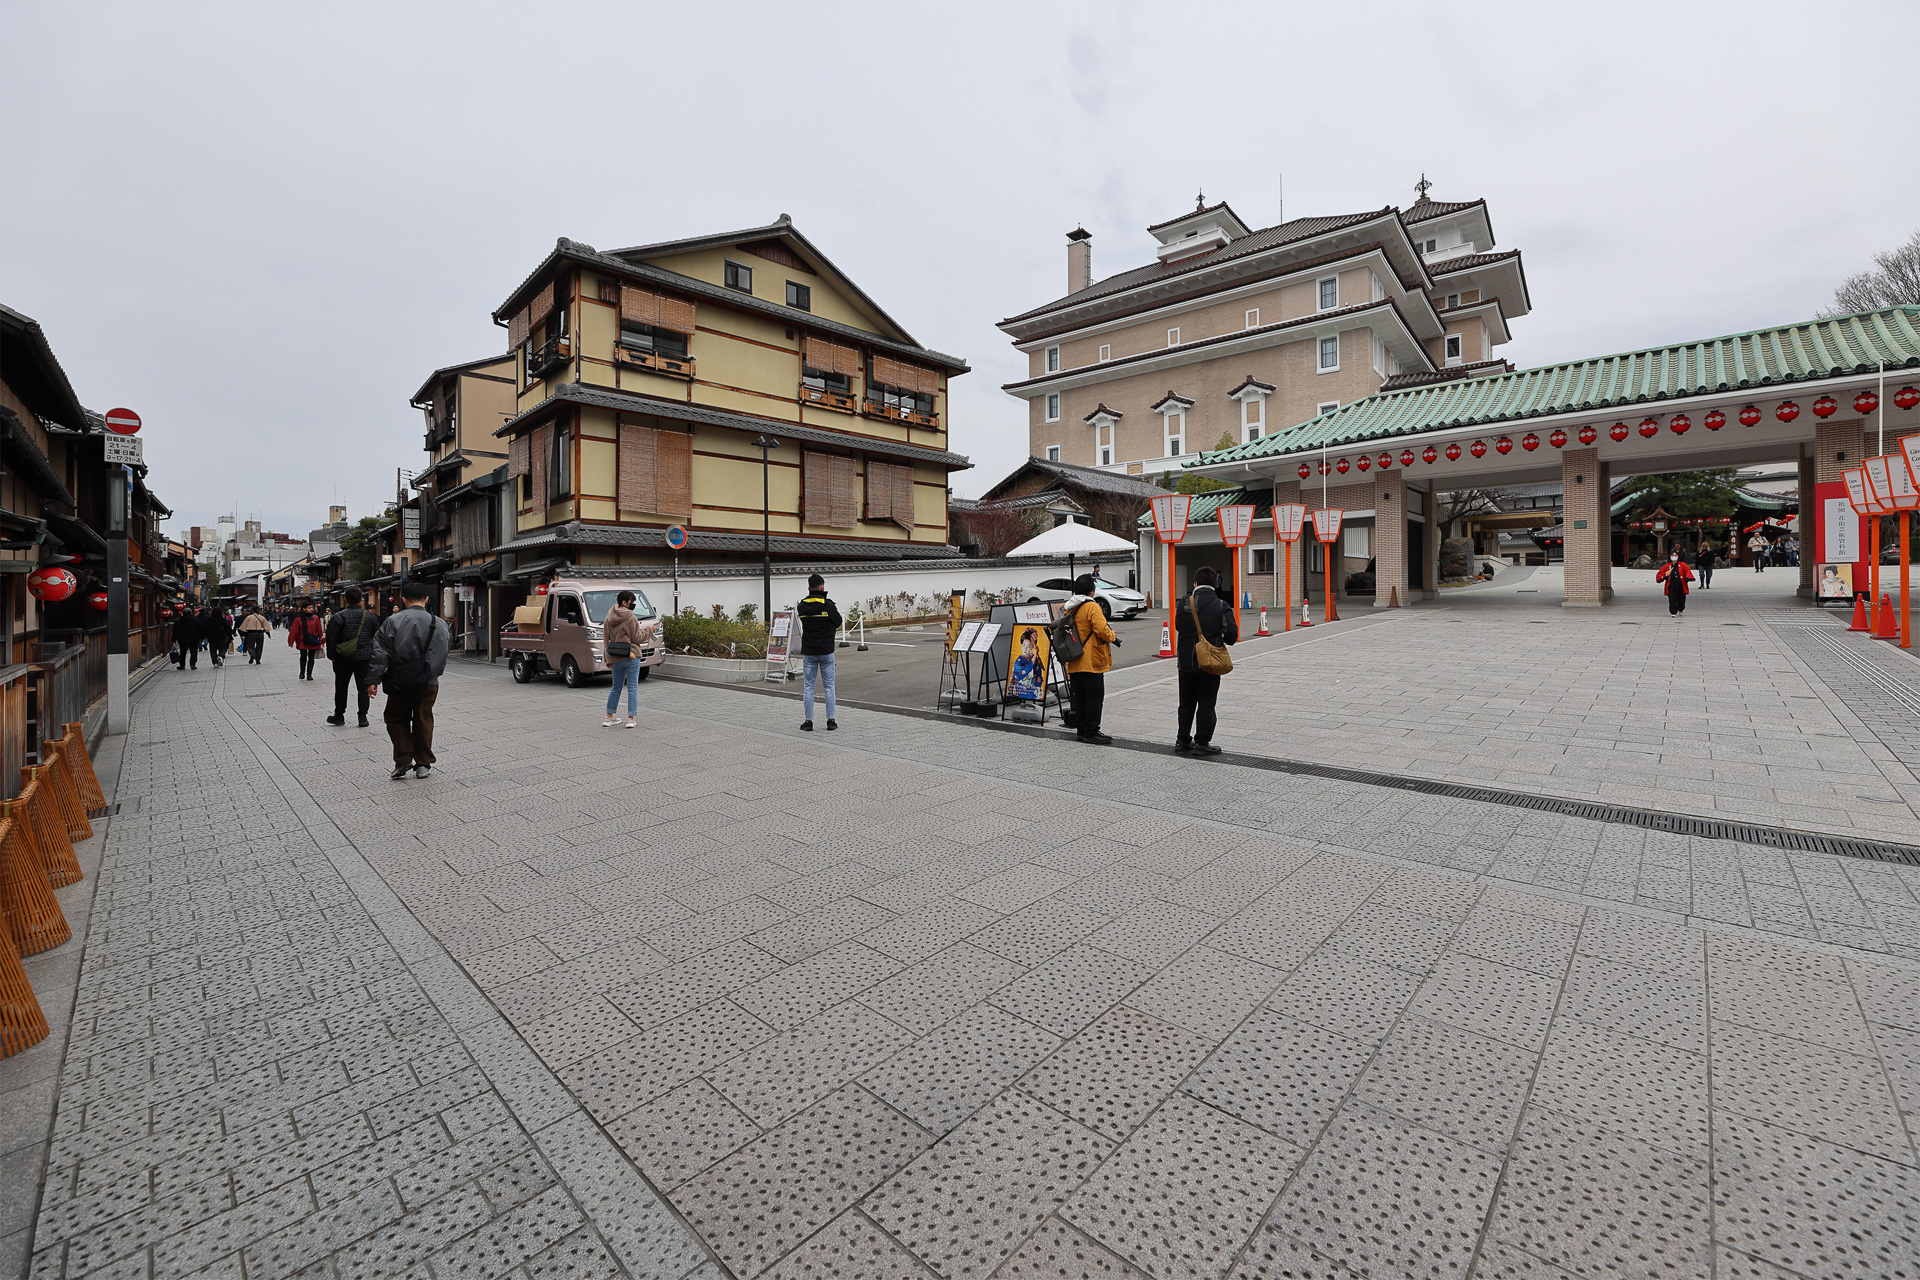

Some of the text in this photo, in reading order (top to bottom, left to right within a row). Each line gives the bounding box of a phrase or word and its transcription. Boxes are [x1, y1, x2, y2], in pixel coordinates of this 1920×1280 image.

[107, 436, 141, 444] 自転車を除く
